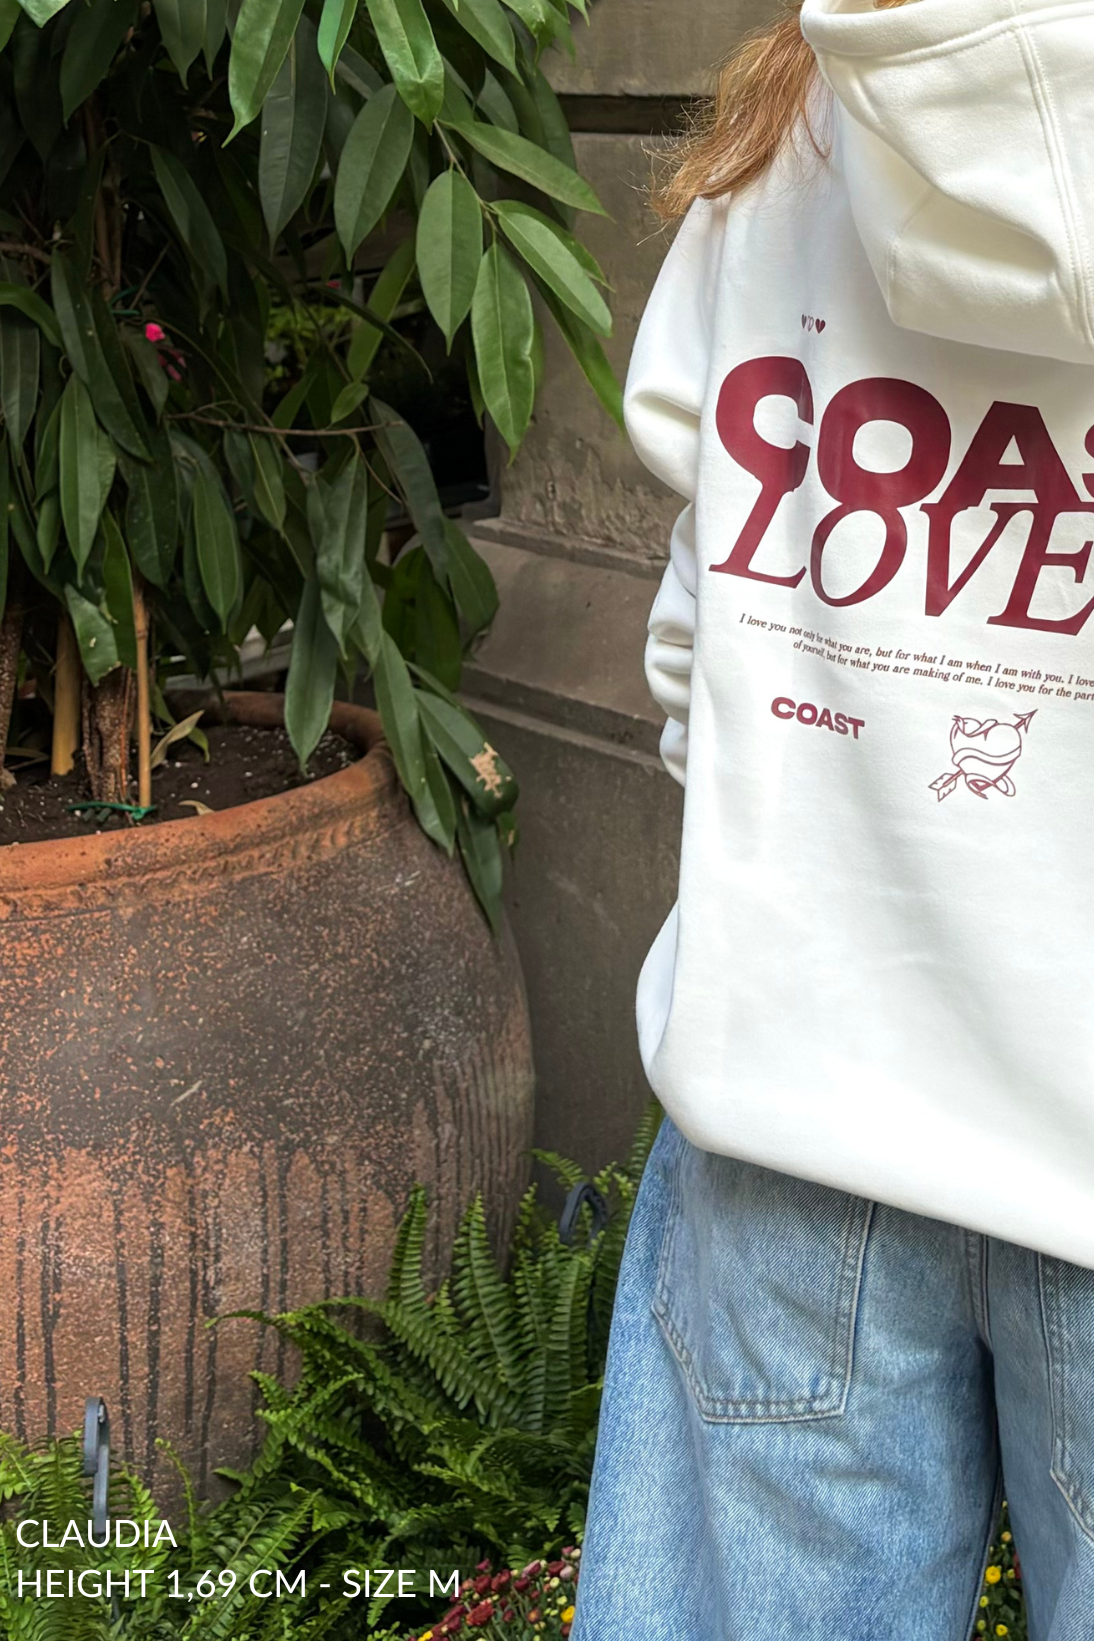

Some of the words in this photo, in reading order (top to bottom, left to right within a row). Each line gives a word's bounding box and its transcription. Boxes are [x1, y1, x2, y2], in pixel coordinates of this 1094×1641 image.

[738, 612, 747, 624] I
[746, 615, 768, 629] love
[767, 622, 787, 633] you
[788, 625, 803, 637] not
[802, 629, 816, 642] only
[823, 637, 838, 650] what
[837, 643, 853, 653] you
[854, 646, 873, 658] are,
[875, 646, 894, 659] but
[894, 648, 912, 661] for
[913, 651, 938, 665] what
[938, 654, 947, 666] I
[948, 659, 964, 669] am
[965, 660, 993, 674] when
[994, 663, 1002, 675] I
[1001, 667, 1019, 677] am
[1020, 668, 1043, 681] with
[1042, 673, 1066, 685] you.
[1067, 673, 1075, 685] I
[792, 639, 804, 650] of
[826, 650, 837, 663] but
[836, 653, 849, 666] for
[849, 657, 871, 670] what
[870, 662, 891, 673] you
[891, 665, 911, 675] are
[912, 667, 952, 683] making
[951, 671, 966, 683] of
[964, 675, 984, 687] me.
[986, 675, 994, 687] I
[993, 677, 1016, 690] love
[1016, 683, 1036, 694] you
[1037, 683, 1055, 696] for
[1055, 686, 1073, 698] the
[771, 696, 866, 740] COAST
